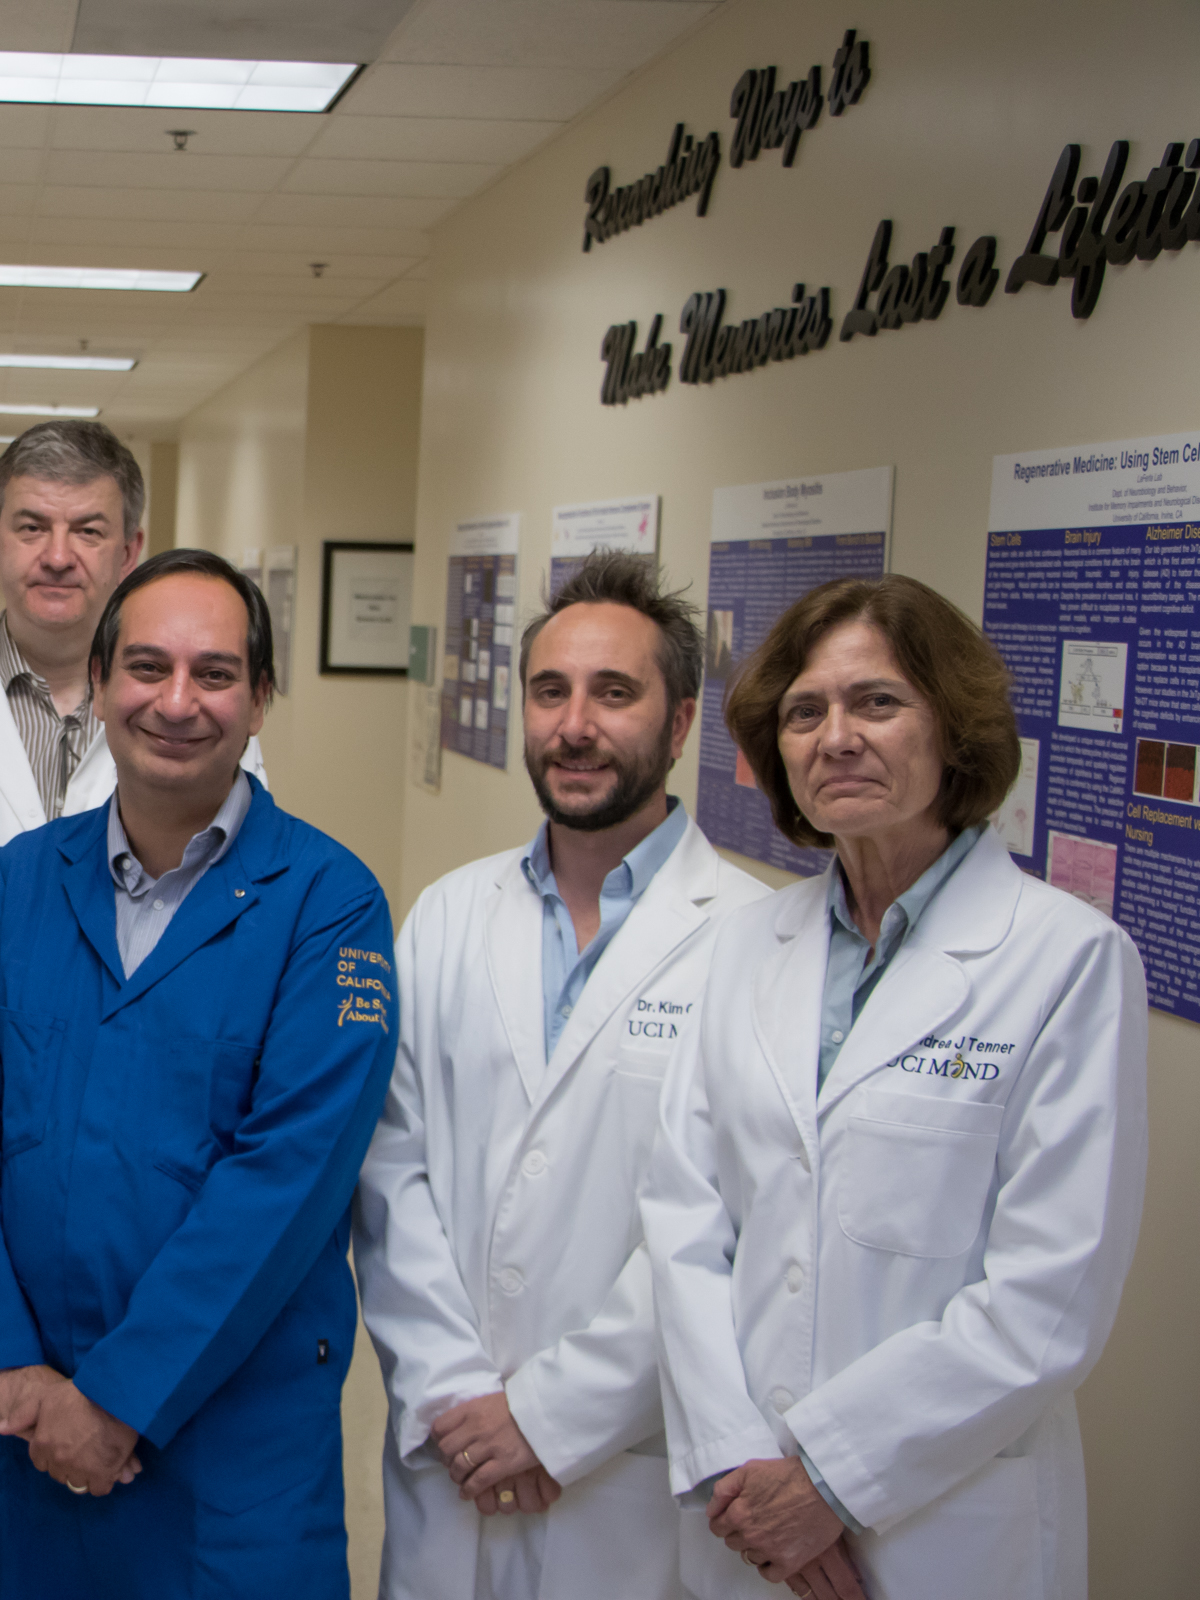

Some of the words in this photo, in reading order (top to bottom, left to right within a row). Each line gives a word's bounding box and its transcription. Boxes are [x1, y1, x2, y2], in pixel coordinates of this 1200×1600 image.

[730, 65, 824, 168] Ways
[828, 29, 871, 117] to
[601, 314, 672, 405] Make
[680, 283, 833, 385] Memories
[840, 219, 955, 342] Last
[956, 236, 1000, 307] a
[1004, 138, 1200, 319] Lifeti
[1013, 459, 1071, 484] Regenerative
[1072, 454, 1118, 475] Medicine:
[1120, 449, 1150, 472] Using
[1152, 446, 1180, 467] Stem
[1182, 443, 1200, 464] Cel
[990, 533, 1006, 547] Stem
[1064, 530, 1082, 545] Brain
[1083, 528, 1102, 547] Injury
[1146, 525, 1184, 541] Alzheimer
[1127, 802, 1141, 819] Cell
[1142, 805, 1193, 830] Replacement
[1125, 824, 1154, 847] Nursing
[337, 960, 356, 973] OF
[355, 996, 370, 1009] Be
[637, 999, 656, 1013] Dr.
[659, 1001, 683, 1015] Kim
[346, 1010, 380, 1023] About
[628, 1019, 664, 1038] UCI
[954, 1036, 966, 1050] J
[969, 1037, 1016, 1054] Tenner
